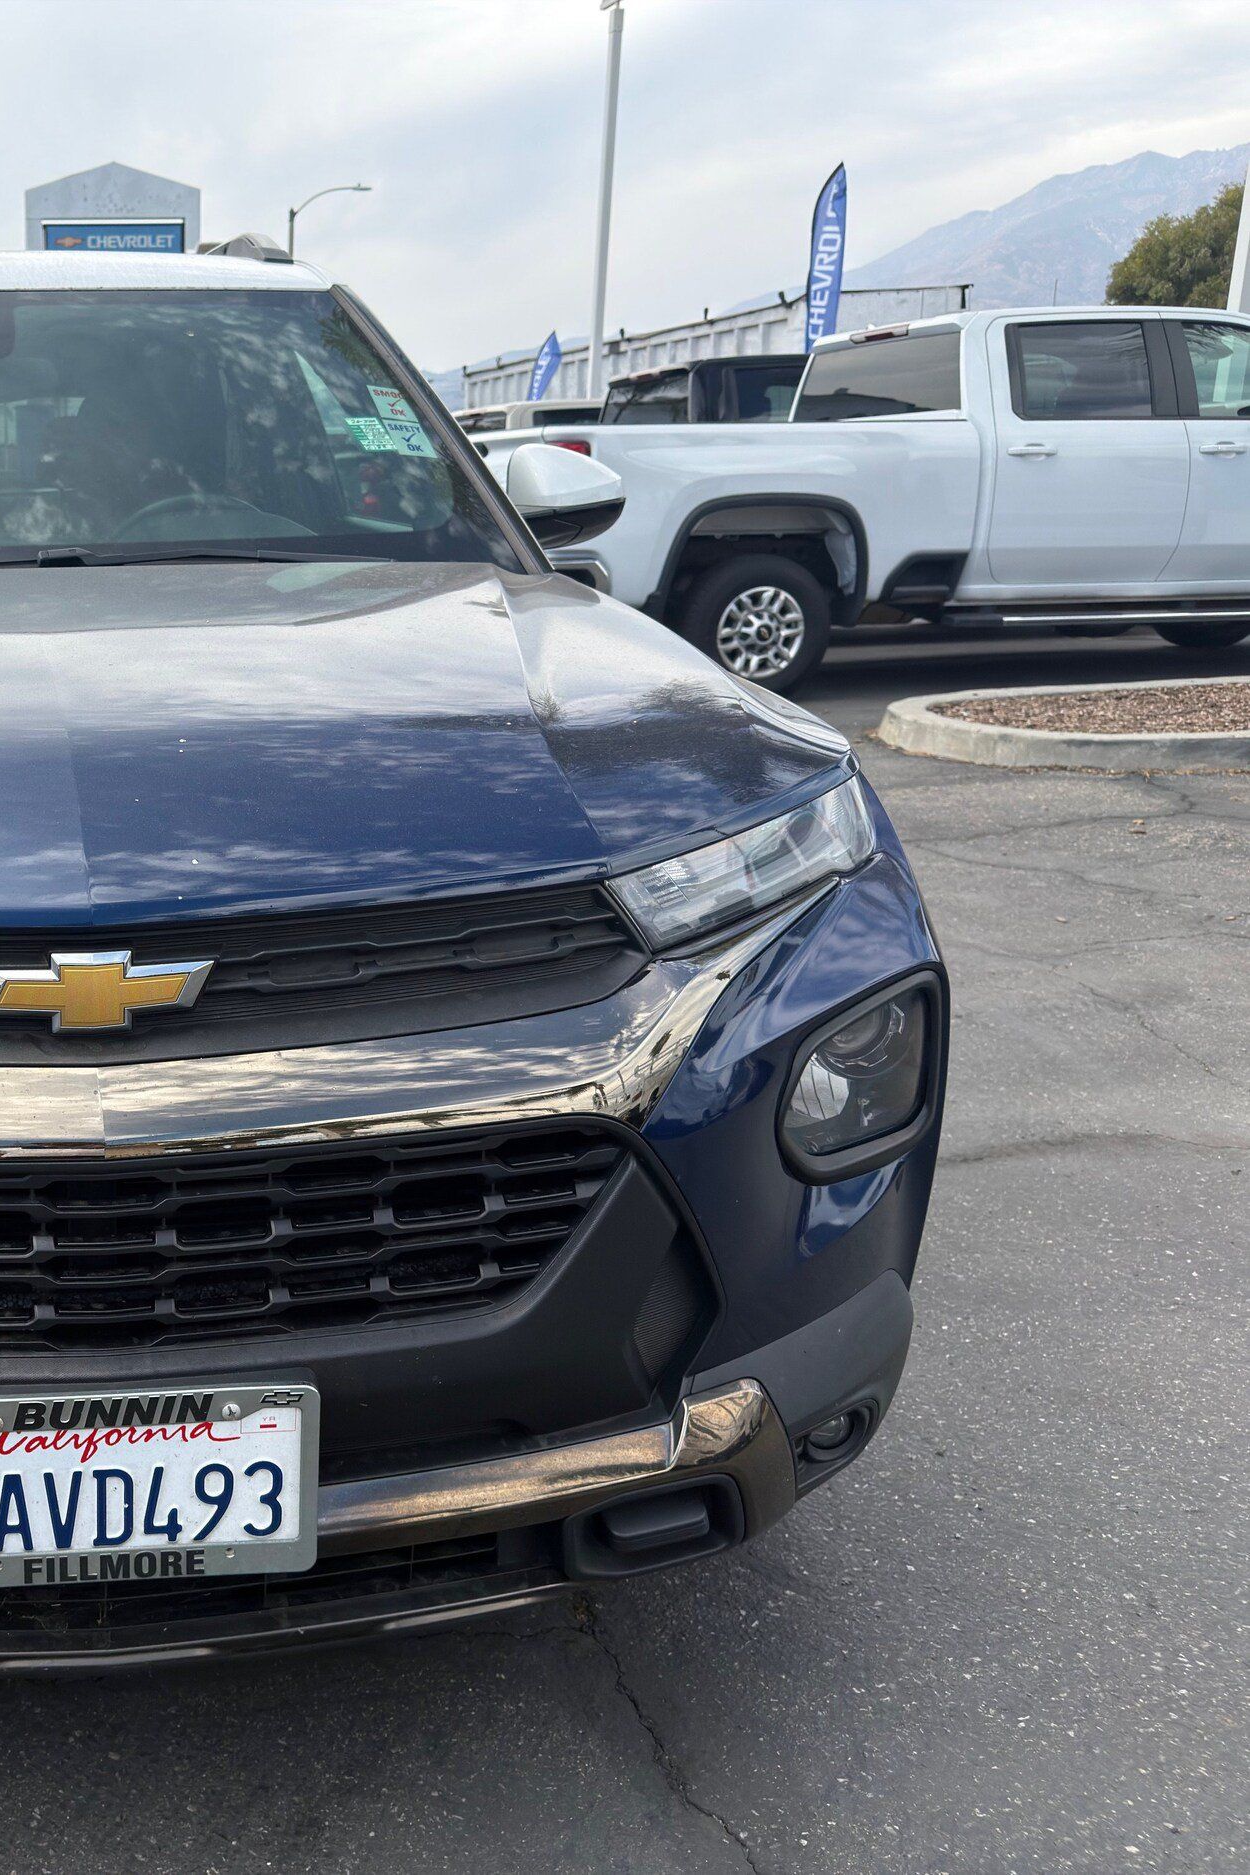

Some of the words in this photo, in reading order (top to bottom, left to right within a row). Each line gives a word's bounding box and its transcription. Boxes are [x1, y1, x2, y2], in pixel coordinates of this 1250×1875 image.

[87, 234, 175, 249] CHEVROLET
[391, 409, 406, 417] OK
[388, 424, 421, 434] SAFETY
[407, 444, 424, 452] OK
[13, 1392, 214, 1431] BUNNIN
[24, 1550, 206, 1584] FILLMORE
